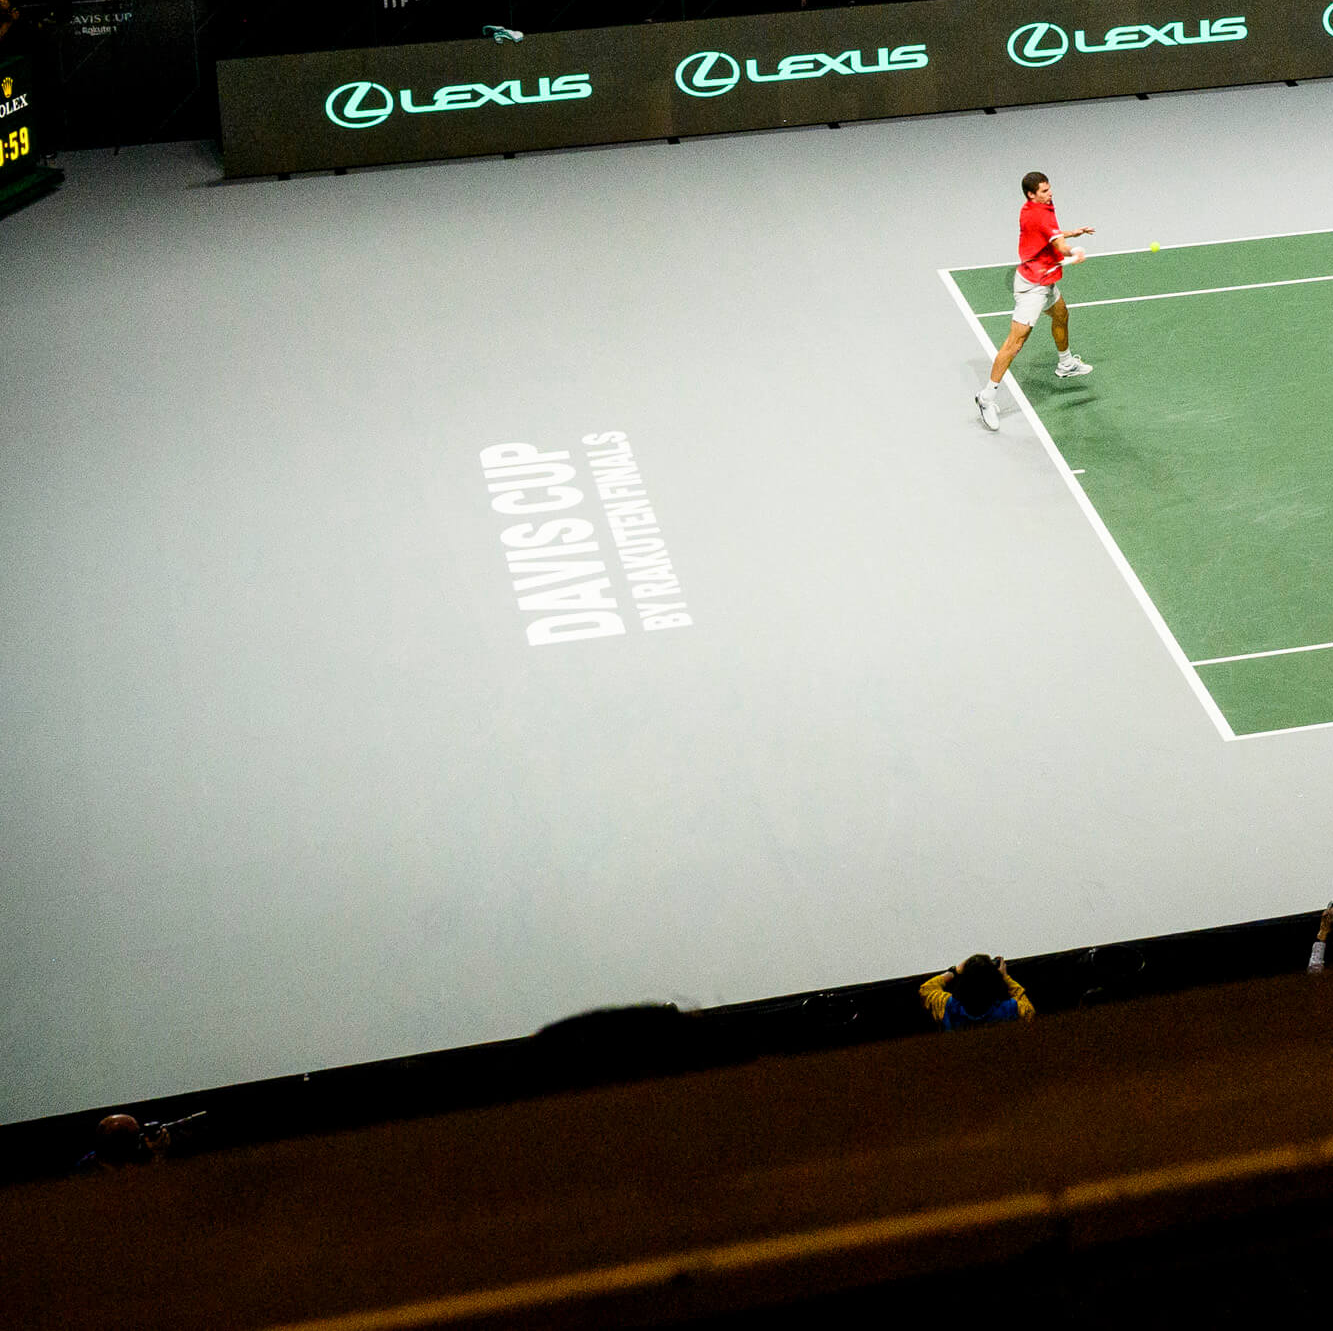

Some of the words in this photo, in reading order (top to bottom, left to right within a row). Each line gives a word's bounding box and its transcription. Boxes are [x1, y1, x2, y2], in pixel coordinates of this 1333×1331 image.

[70, 12, 102, 25] AVIS
[106, 10, 133, 21] CUP
[1075, 16, 1248, 53] LEXUS
[745, 45, 929, 83] LEXUS
[0, 93, 28, 118] OLEX
[400, 74, 593, 113] LEXUS
[479, 442, 584, 515] CUP
[581, 430, 647, 501] FINALS
[603, 499, 681, 600] RAKUTEN
[500, 517, 626, 646] DAVIS
[636, 601, 693, 631] BY
